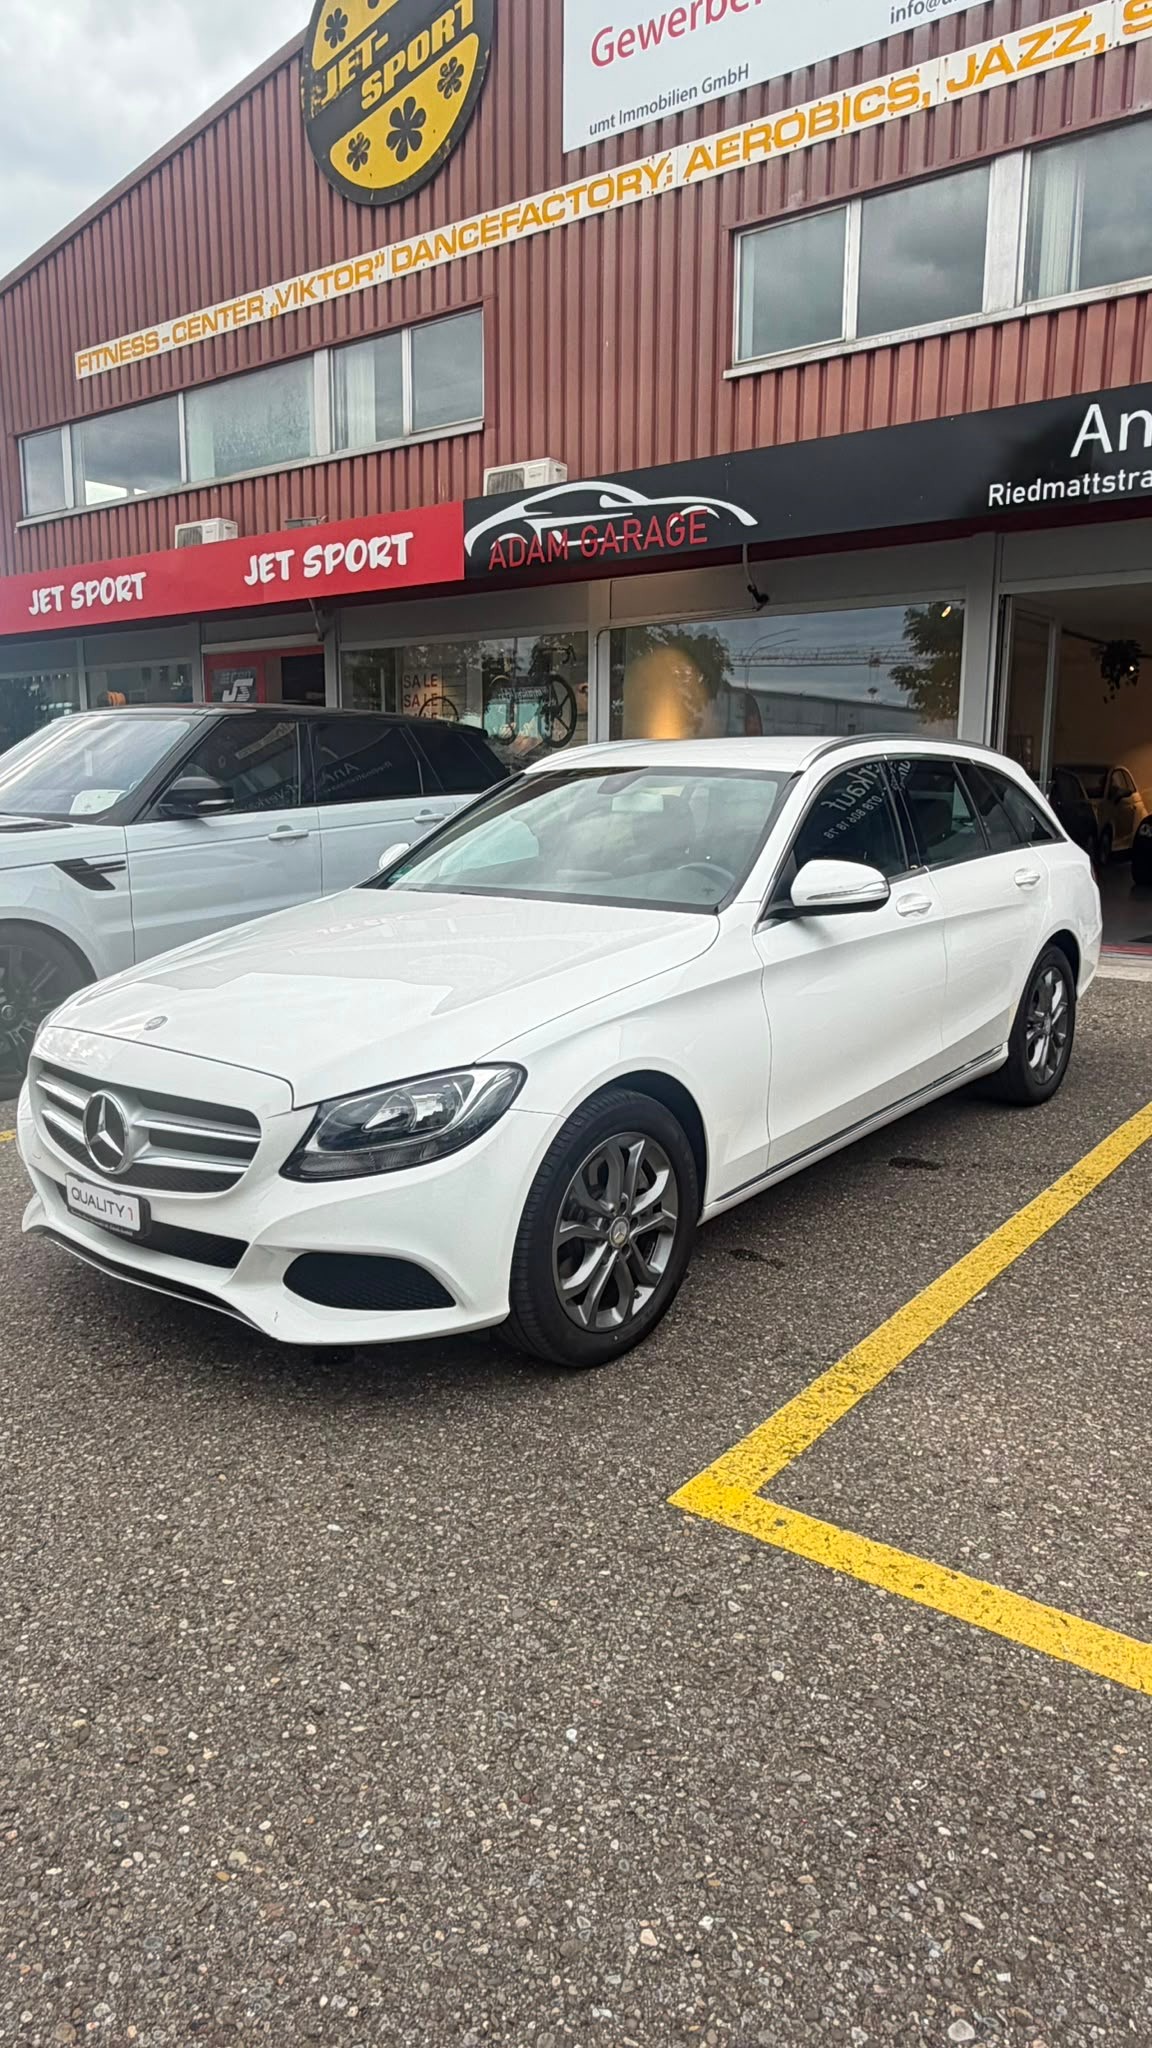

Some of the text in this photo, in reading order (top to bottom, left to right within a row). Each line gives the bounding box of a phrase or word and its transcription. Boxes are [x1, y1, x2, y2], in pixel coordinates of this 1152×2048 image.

[361, 0, 473, 110] SPORT
[589, 63, 750, 136] umt Immobilien GmbH
[391, 155, 673, 273] DANCEFACTORY:
[683, 74, 931, 180] AEROBICS,
[946, 14, 1106, 94] JAZZ,
[1070, 403, 1152, 458] An
[988, 469, 1152, 507] Riedmattstra
[243, 532, 413, 586] JET SPORT
[488, 509, 708, 570] ADAM GARAGE
[28, 571, 147, 615] JET SPORT
[71, 1187, 134, 1221] QUALITY 1
